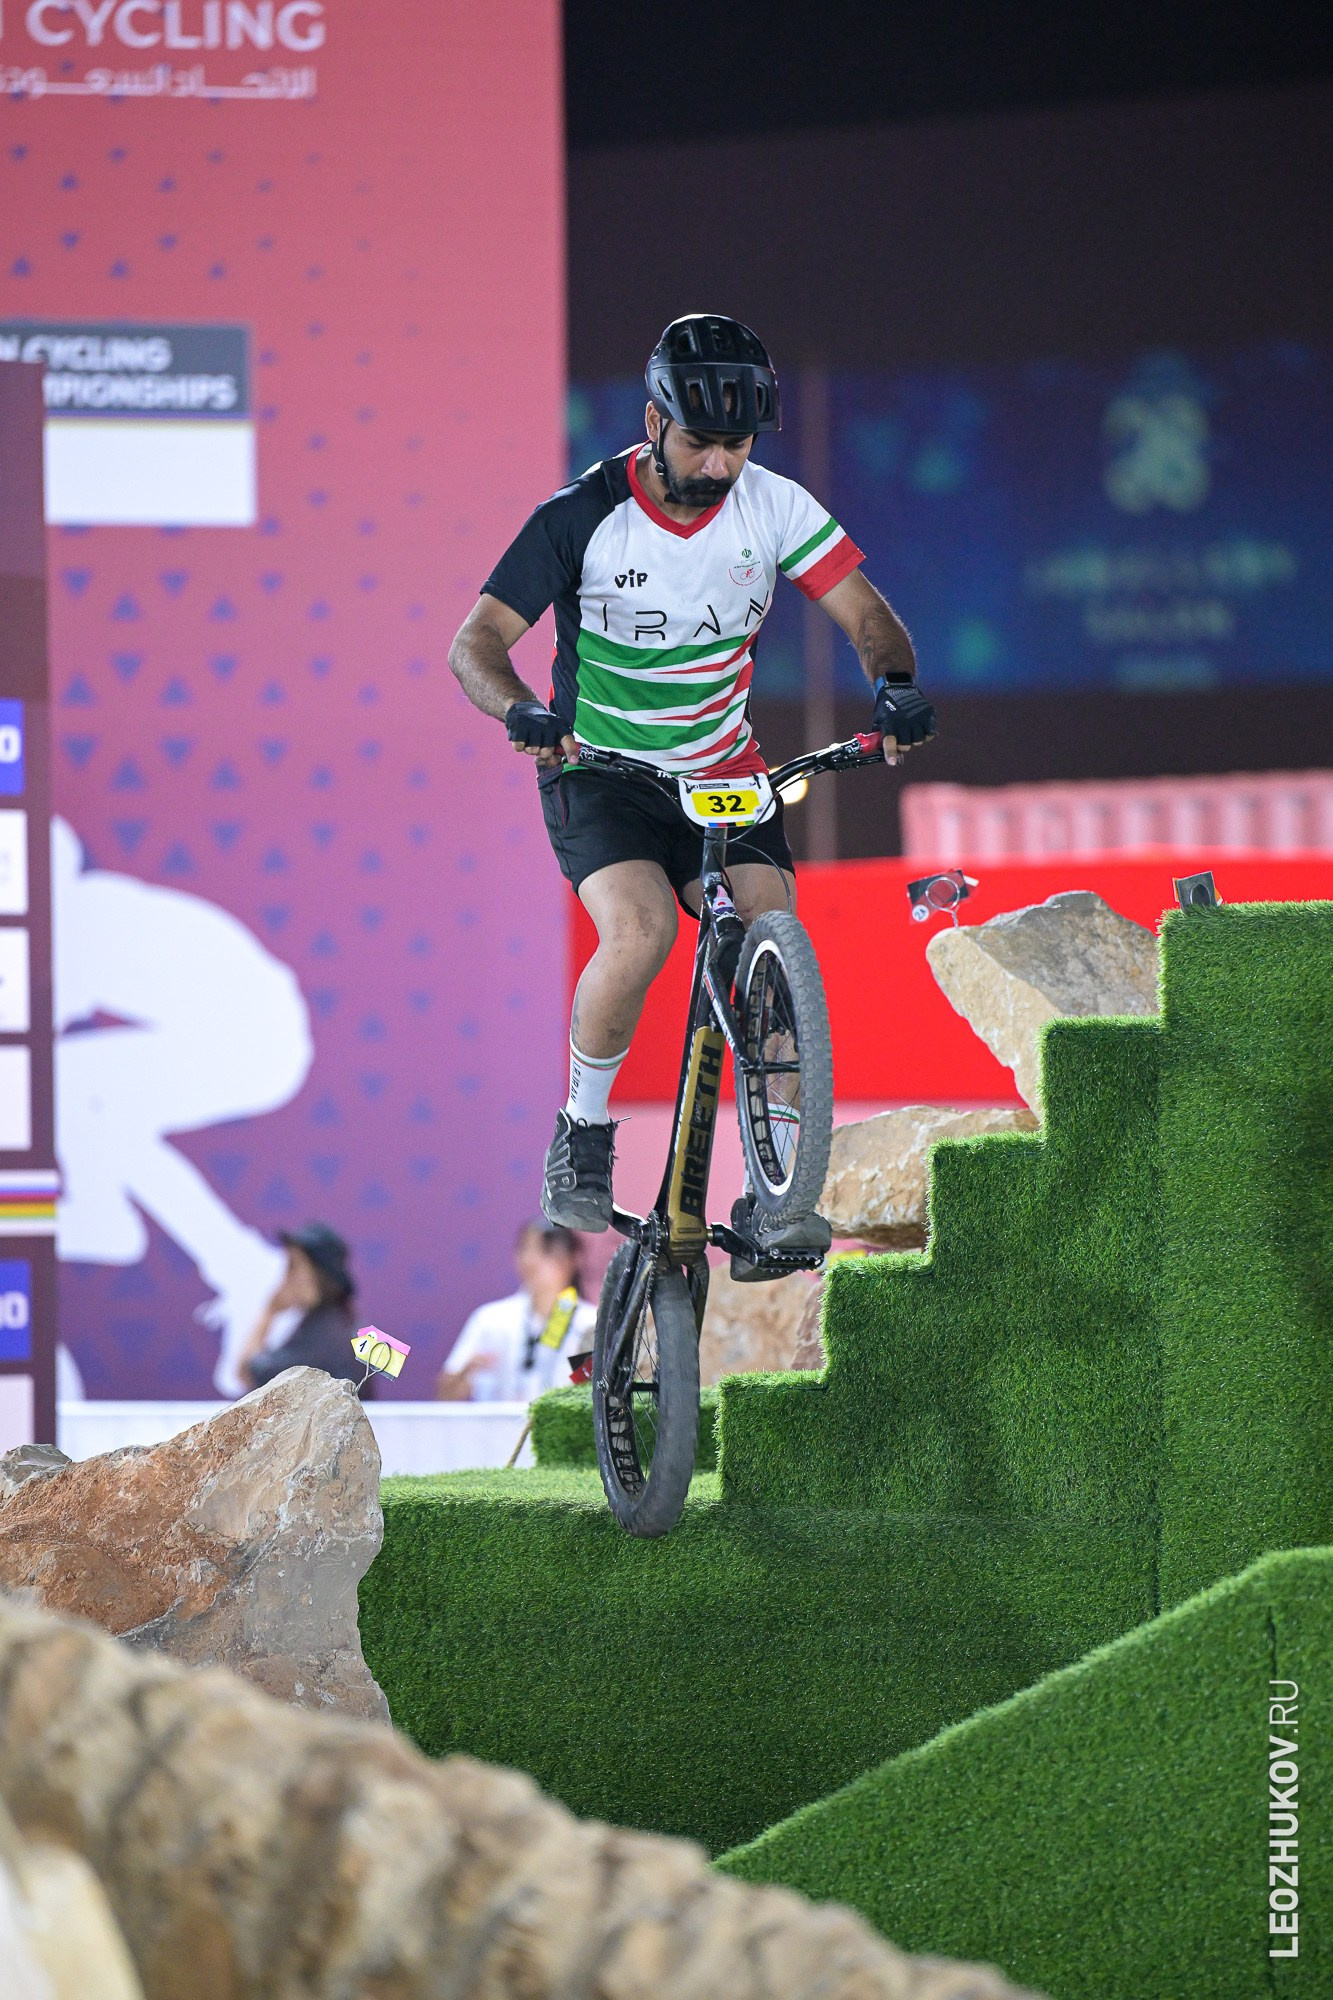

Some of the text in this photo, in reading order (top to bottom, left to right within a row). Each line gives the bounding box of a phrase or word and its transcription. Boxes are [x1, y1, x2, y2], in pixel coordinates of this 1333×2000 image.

[25, 0, 326, 50] CYCLING
[602, 589, 769, 641] IRAN
[707, 794, 746, 814] 32
[359, 1340, 368, 1353] 1
